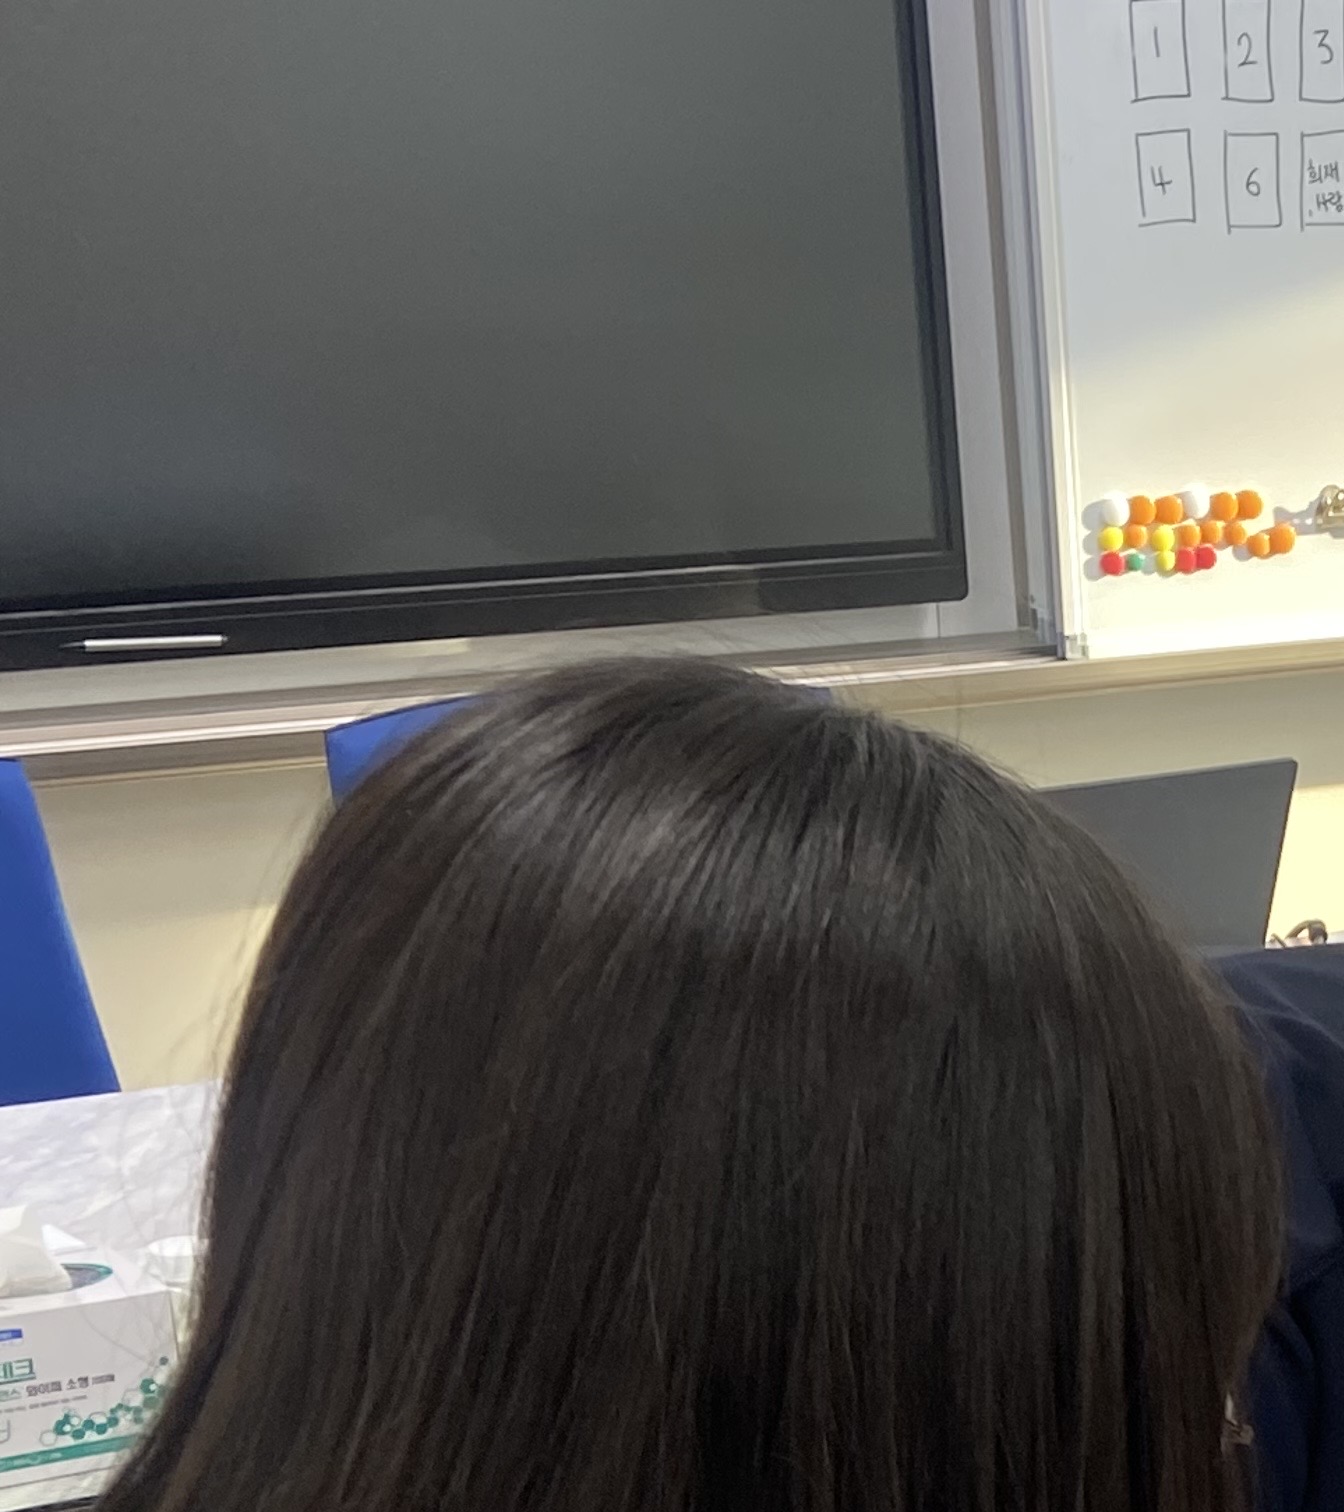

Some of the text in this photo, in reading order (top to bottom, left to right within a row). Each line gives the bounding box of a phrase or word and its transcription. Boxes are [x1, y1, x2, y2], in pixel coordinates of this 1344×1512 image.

[1153, 26, 1334, 67] 1 2 3
[1151, 165, 1261, 196] 4 6
